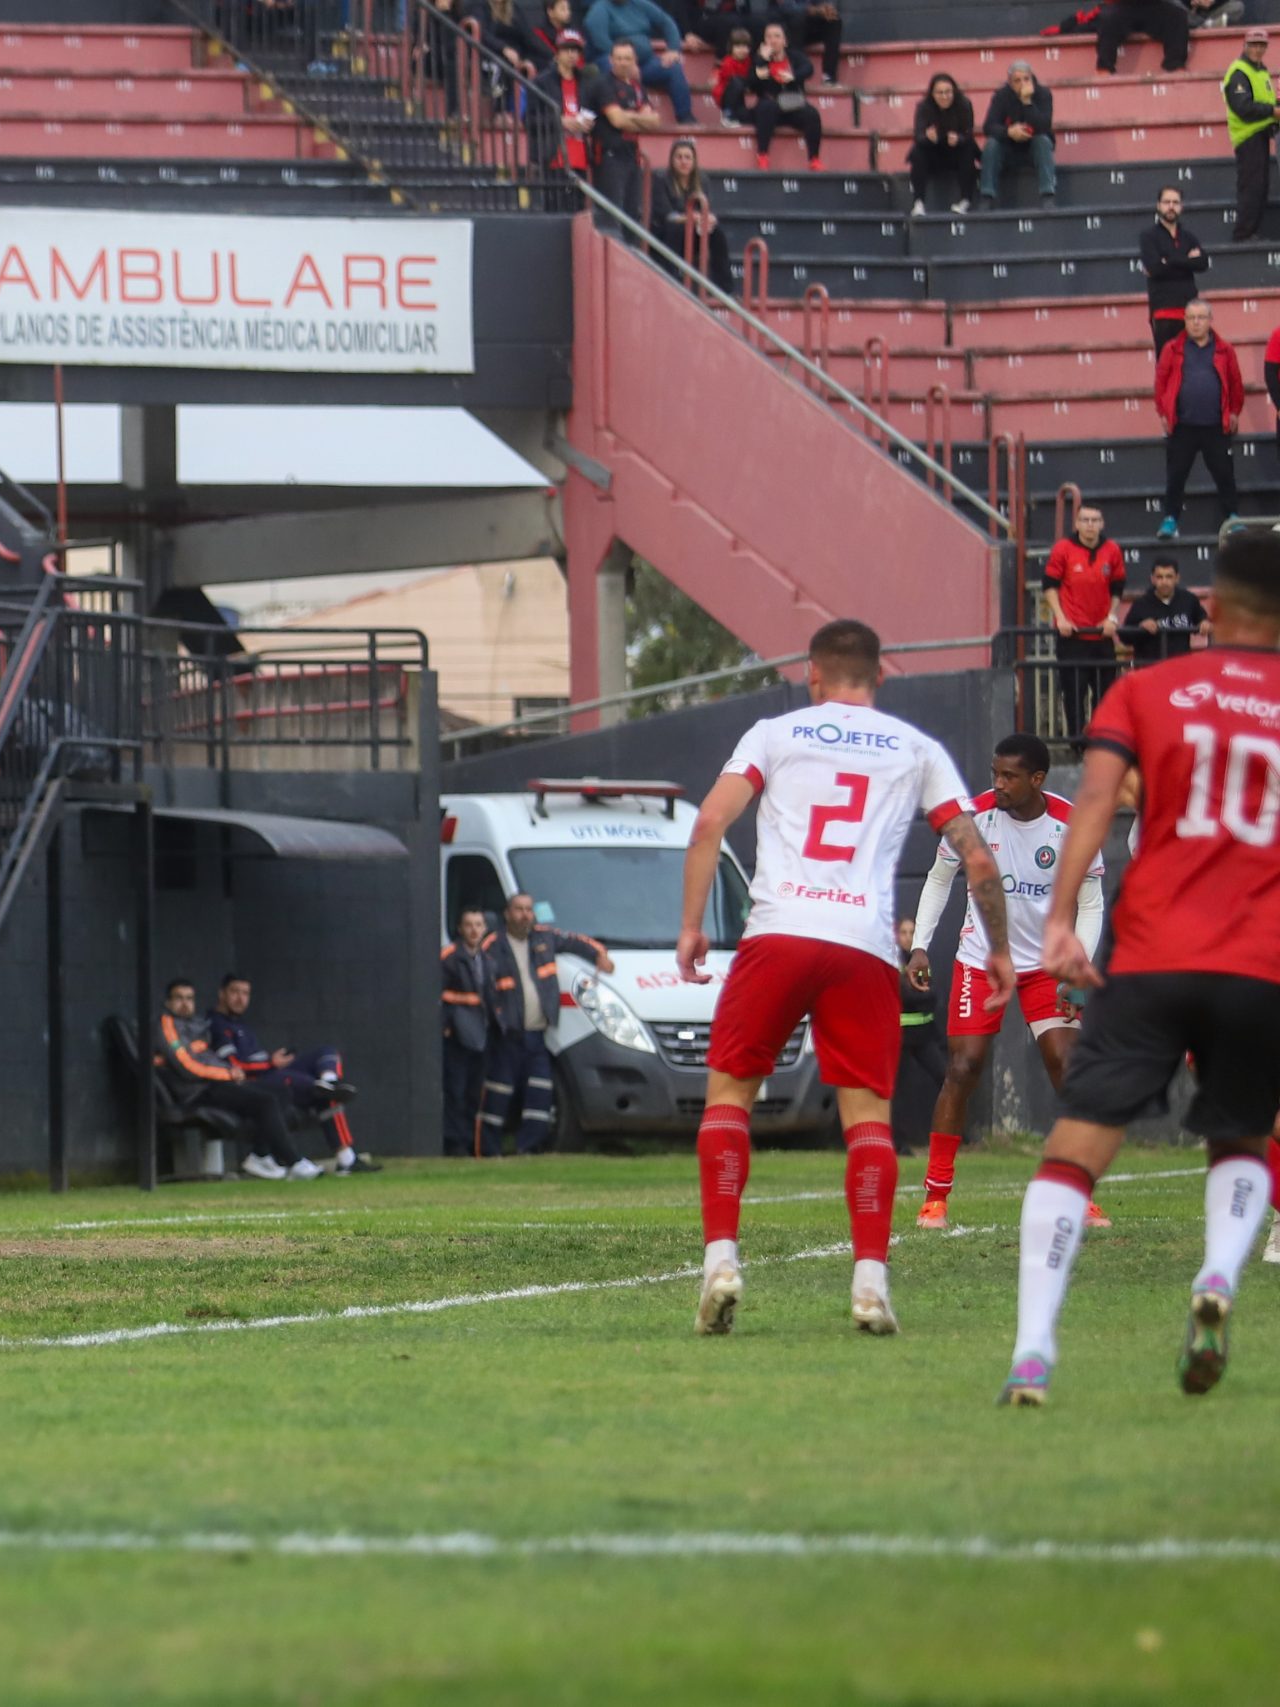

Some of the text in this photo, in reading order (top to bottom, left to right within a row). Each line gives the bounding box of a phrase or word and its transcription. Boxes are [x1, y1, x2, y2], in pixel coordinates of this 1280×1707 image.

[75, 315, 103, 348] DE
[108, 309, 241, 350] ASSISTÊNCIA
[244, 311, 320, 352] MÉDICA
[325, 320, 438, 354] DOMICILIAR
[792, 723, 899, 750] PROJETEC
[803, 772, 869, 863] 2
[1176, 724, 1280, 847] 10
